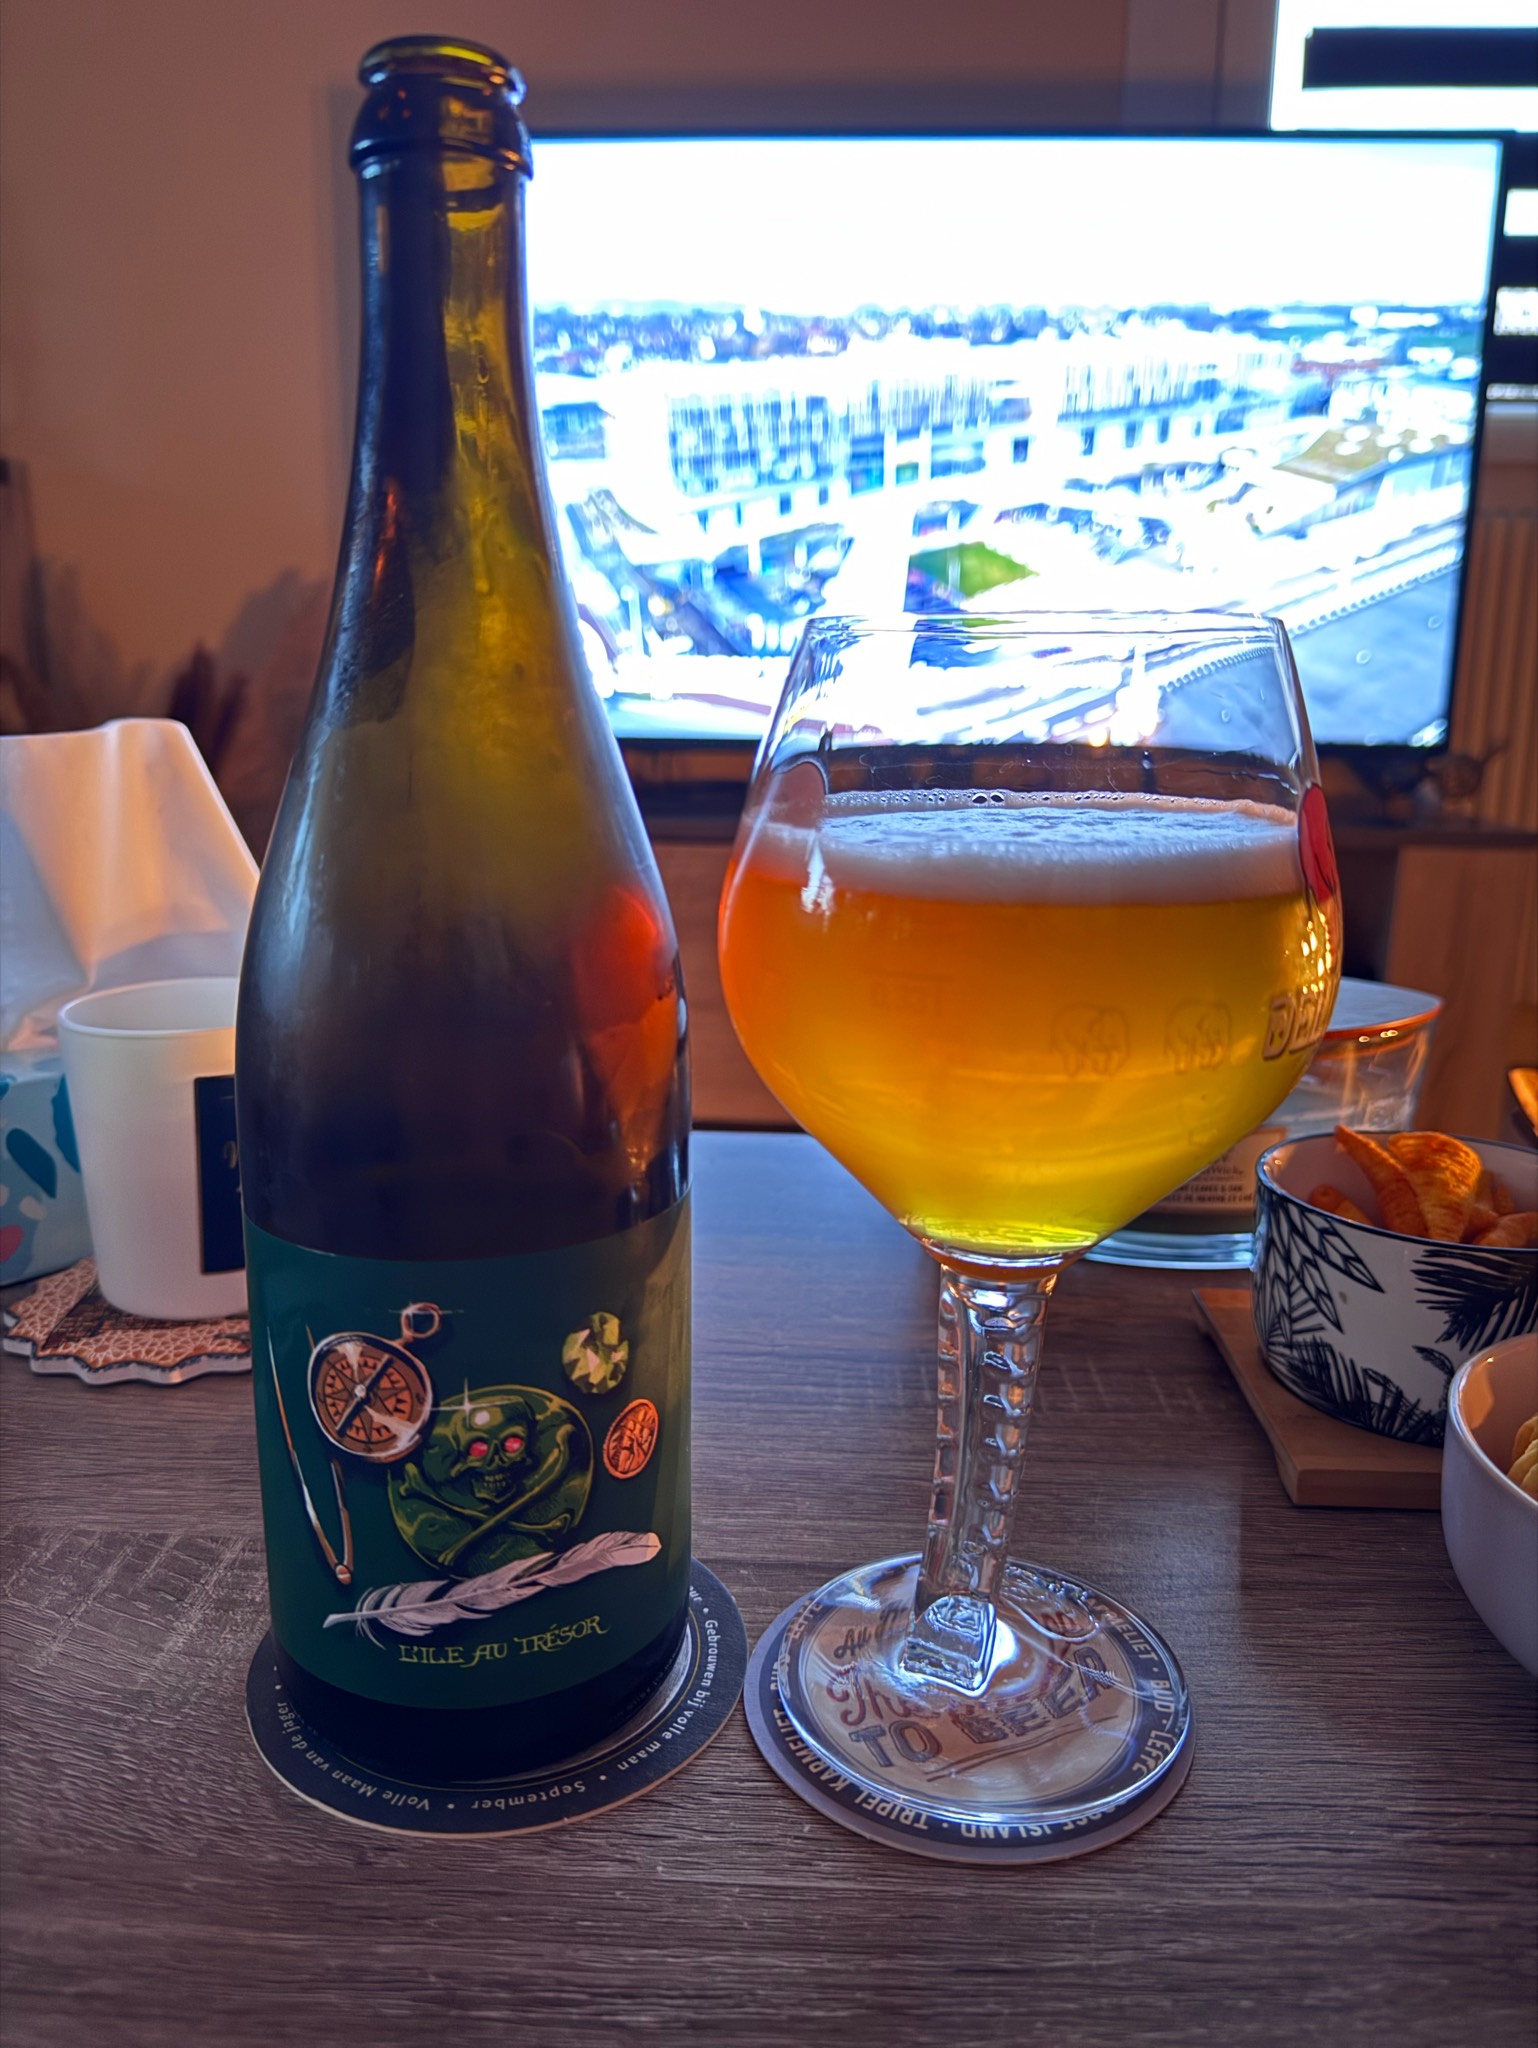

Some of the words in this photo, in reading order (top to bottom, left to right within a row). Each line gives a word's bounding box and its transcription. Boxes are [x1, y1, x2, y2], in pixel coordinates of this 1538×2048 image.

[398, 1644, 465, 1664] L'ILE
[459, 1643, 508, 1668] AU
[513, 1615, 611, 1655] TRÉSOR
[701, 1619, 721, 1687] Gebrouwen
[687, 1689, 711, 1708] bij
[1150, 1679, 1175, 1714] BUD
[277, 1702, 301, 1734] jager
[661, 1710, 694, 1740] volle
[291, 1734, 308, 1750] de
[617, 1740, 662, 1771] maan
[773, 1709, 851, 1792] KARMELIET
[849, 1720, 943, 1768] TO
[305, 1750, 330, 1772] van
[332, 1770, 378, 1797] Maan
[470, 1780, 586, 1811] September
[382, 1790, 430, 1811] Volle
[854, 1791, 929, 1830] TRIPEL
